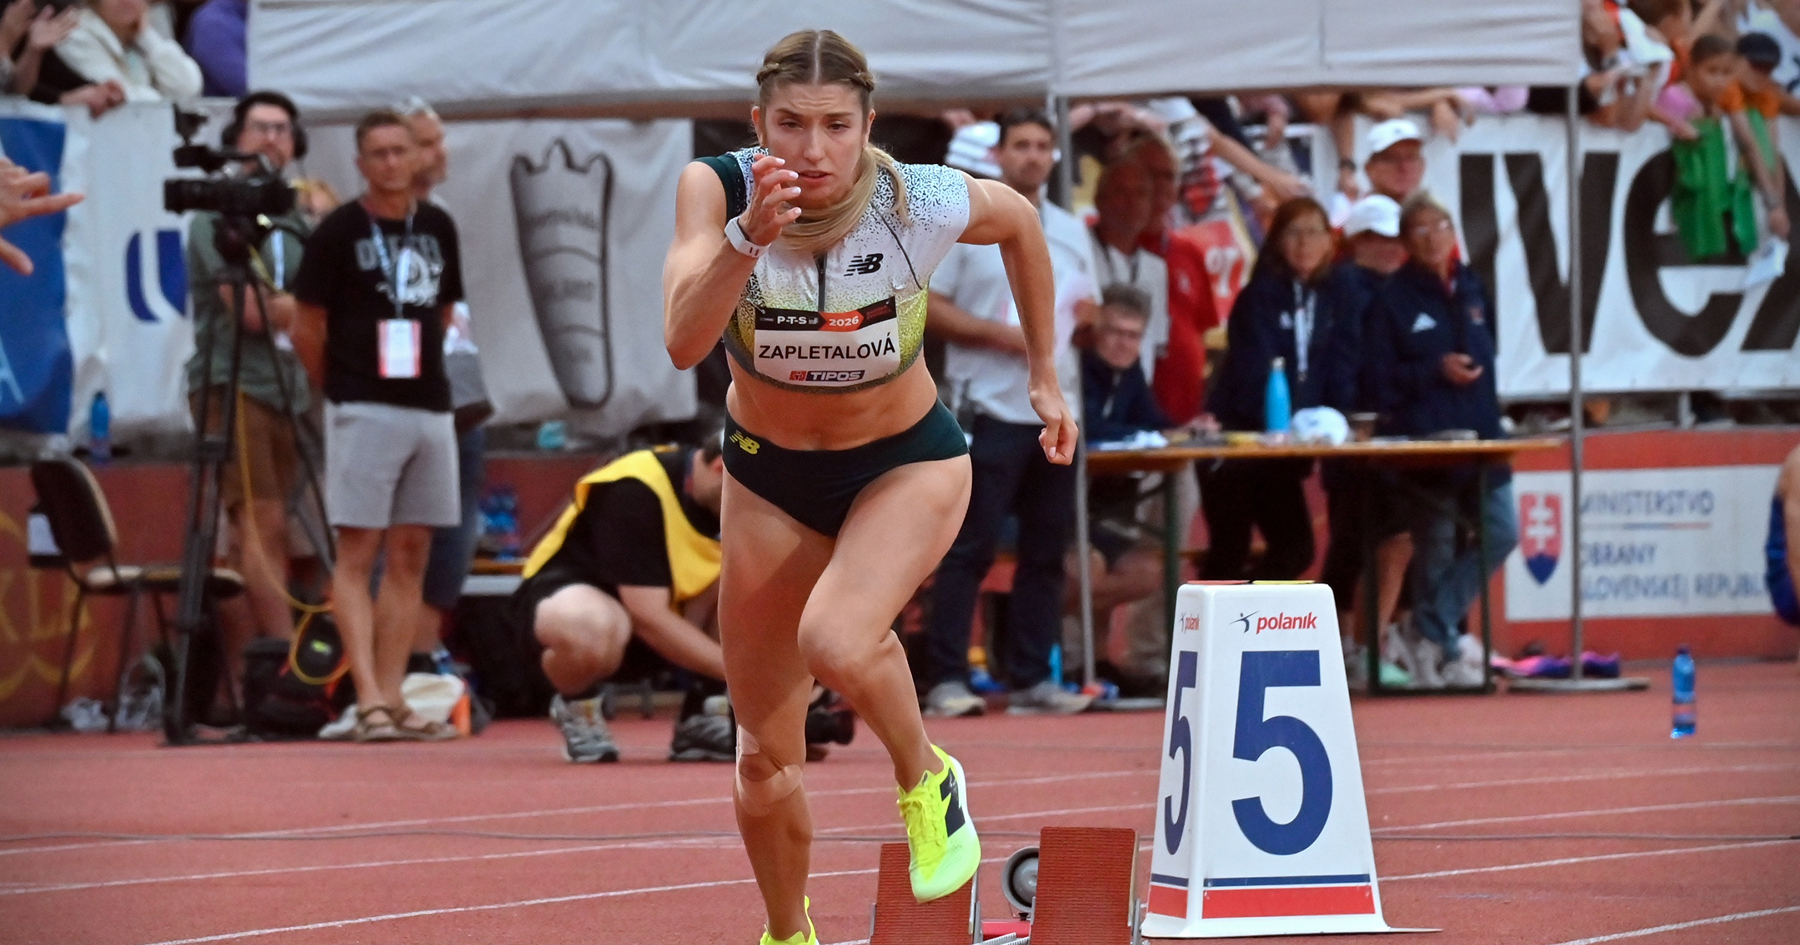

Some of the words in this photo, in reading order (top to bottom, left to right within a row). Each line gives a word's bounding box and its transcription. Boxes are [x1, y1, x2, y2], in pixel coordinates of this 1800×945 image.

[829, 316, 860, 327] 2026
[758, 332, 896, 359] ZAPLETALOVÁ
[810, 371, 862, 381] TIPOS
[1580, 573, 1689, 603] LOVENSKEJ
[1256, 611, 1318, 635] polanik
[1164, 650, 1198, 856] 5
[1231, 649, 1333, 856] 5
